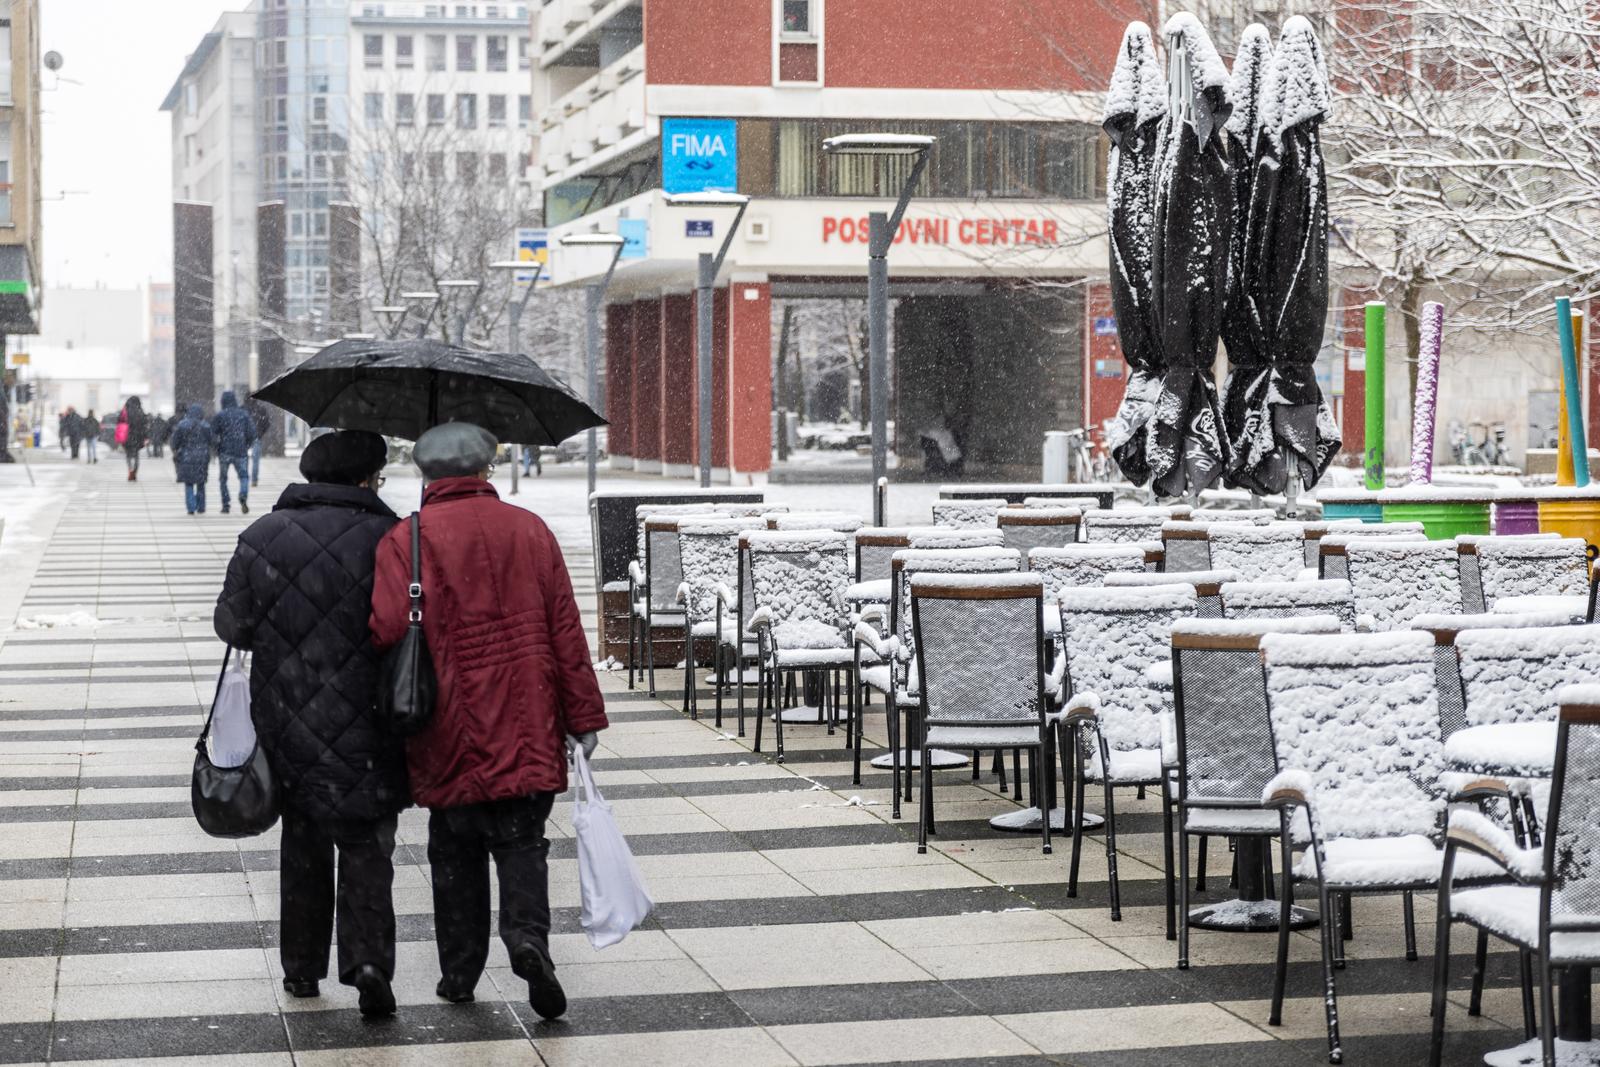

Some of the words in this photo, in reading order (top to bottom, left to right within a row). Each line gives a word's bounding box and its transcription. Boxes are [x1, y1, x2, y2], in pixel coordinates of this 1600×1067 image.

[671, 133, 727, 157] FIMA
[823, 217, 949, 244] POSOVNI
[959, 219, 1058, 244] CENTAR
